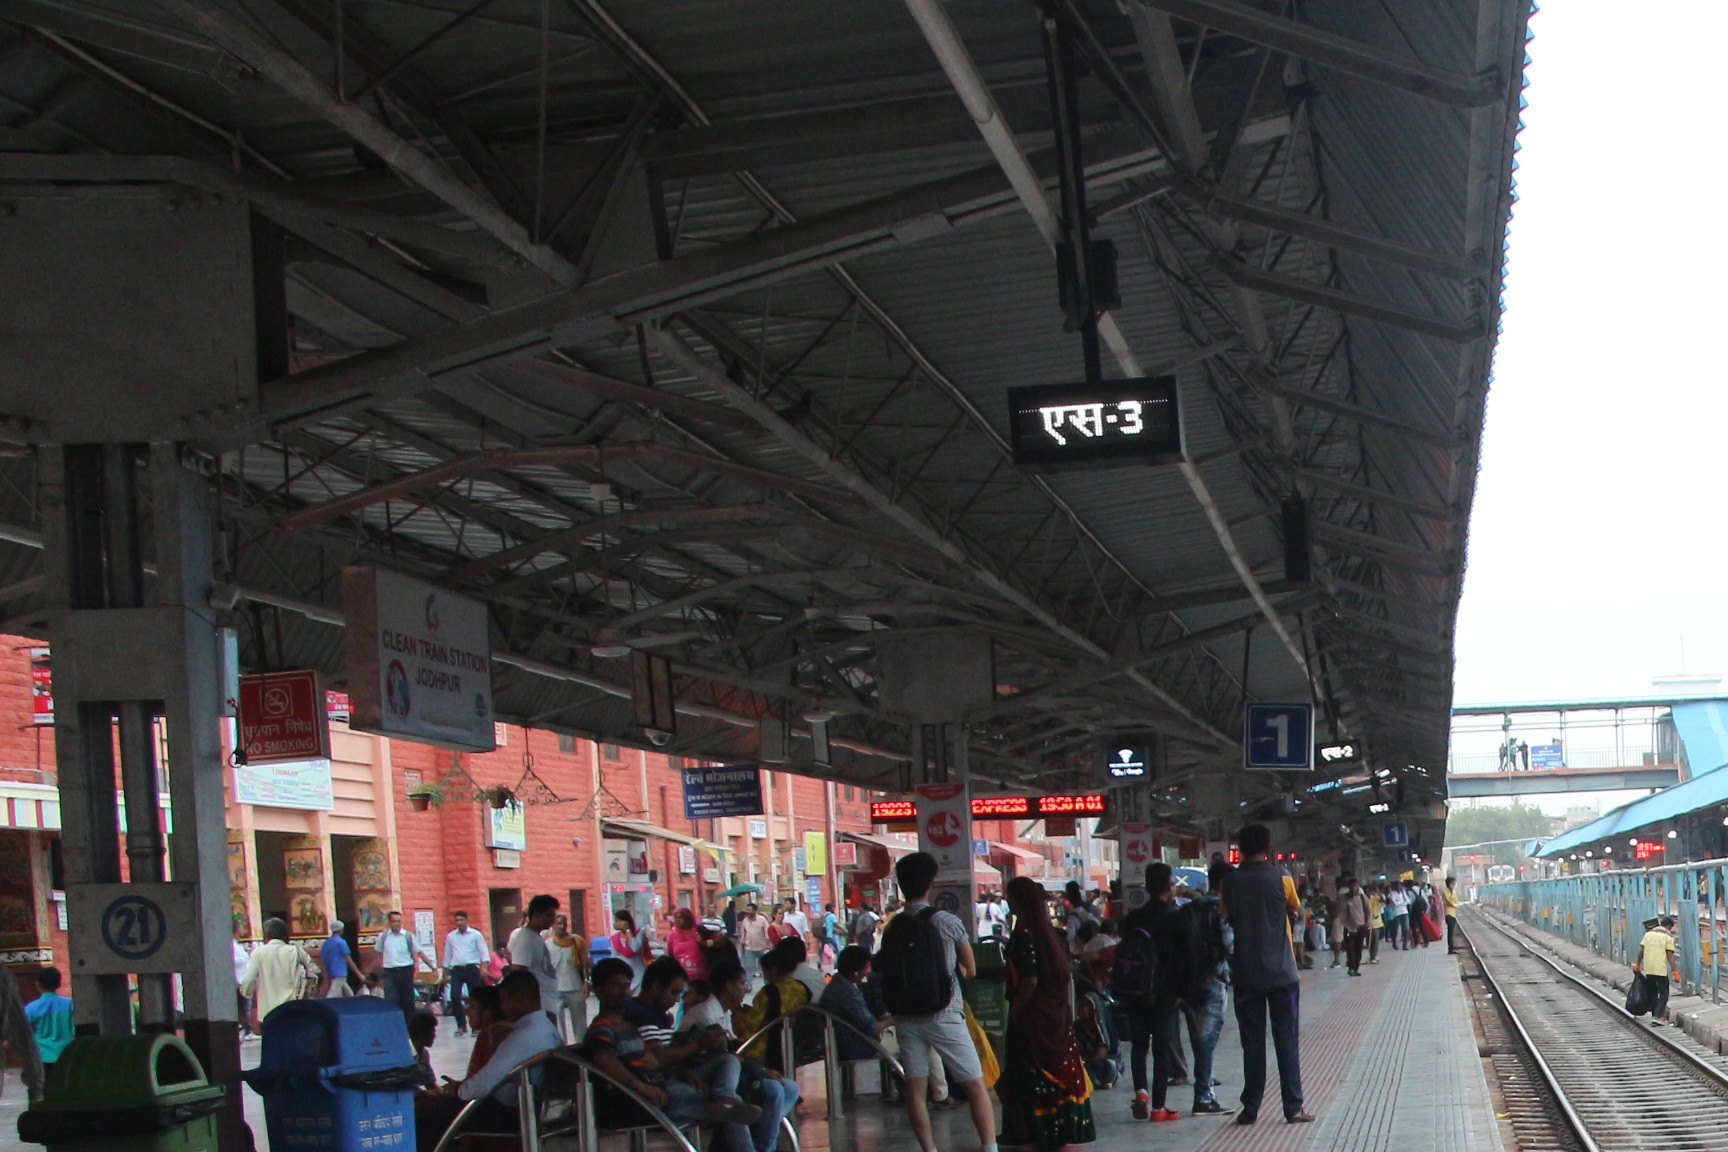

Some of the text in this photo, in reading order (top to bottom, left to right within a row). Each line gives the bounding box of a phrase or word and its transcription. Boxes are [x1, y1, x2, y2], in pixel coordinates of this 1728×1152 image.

[1039, 400, 1143, 446] एस-3
[382, 628, 488, 674] CLEAN TRAIN STATION
[415, 665, 462, 694] JODHPUR
[245, 737, 314, 754] NO SMOKING
[1266, 713, 1289, 758] 1
[970, 797, 1028, 814] EXPRESS
[1390, 826, 1400, 842] 1
[114, 905, 150, 946] 21
